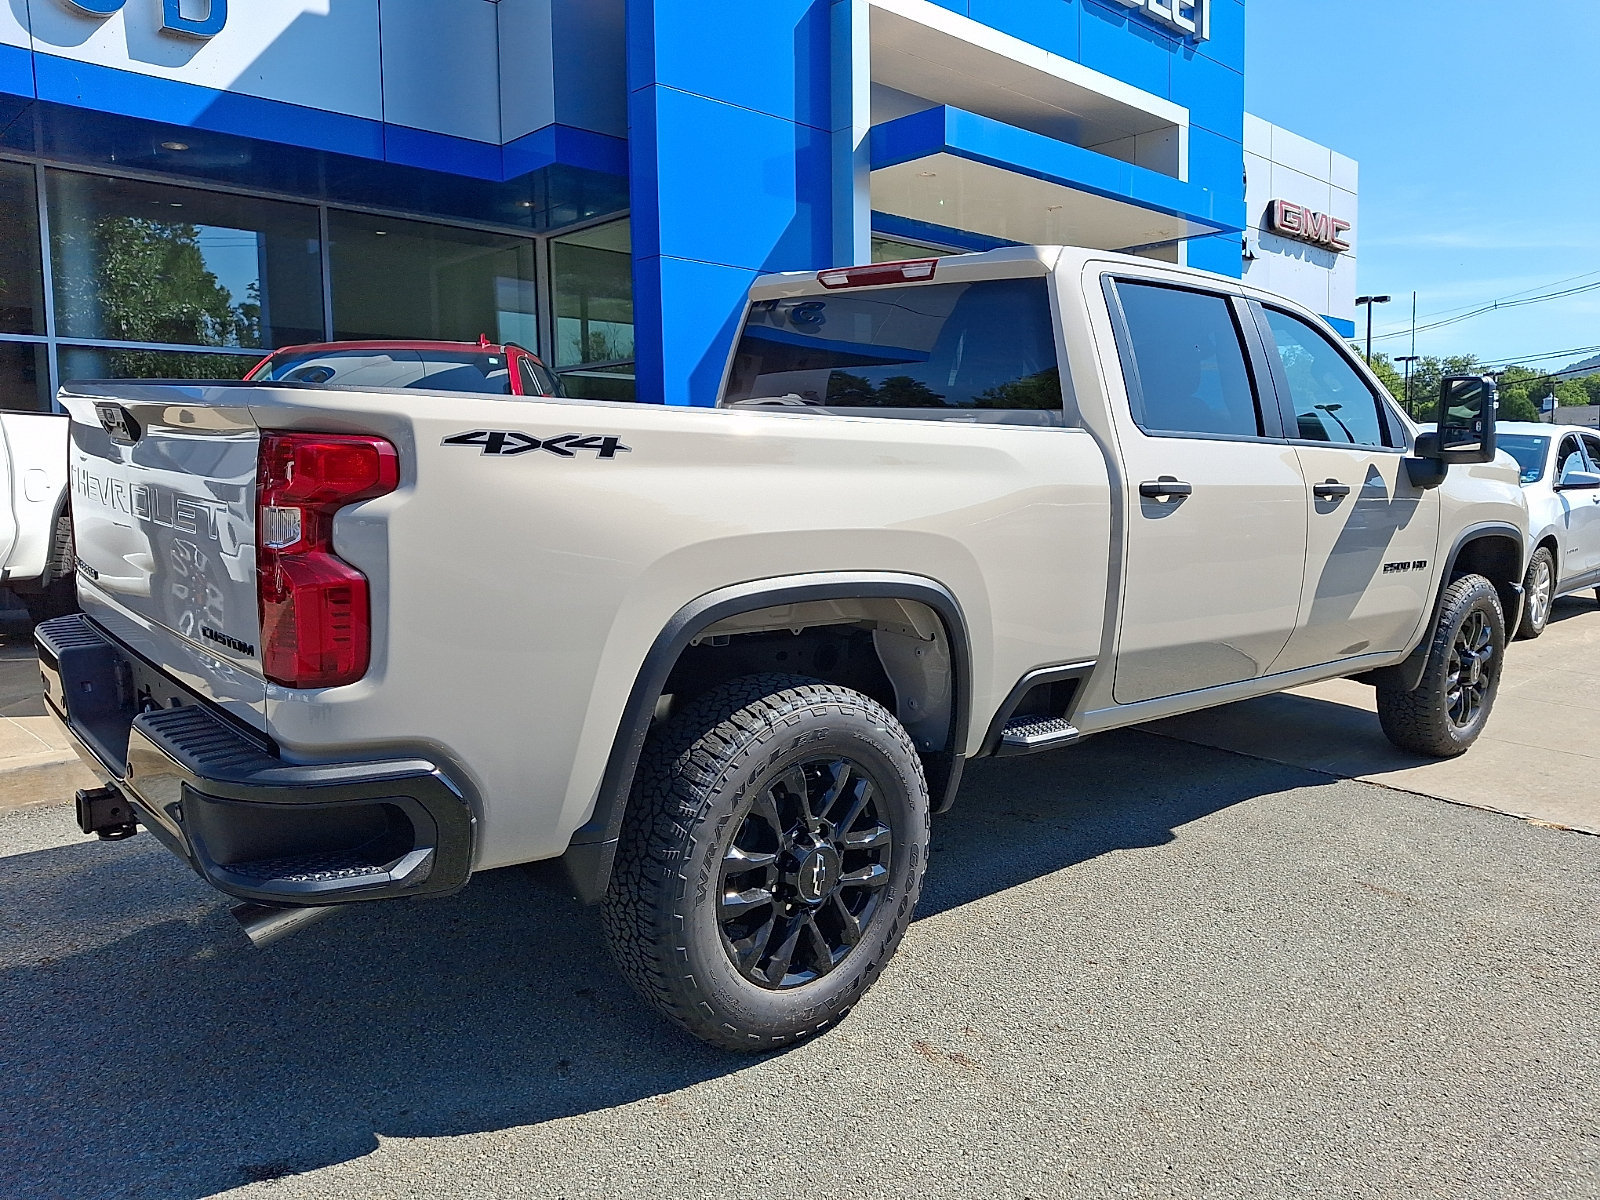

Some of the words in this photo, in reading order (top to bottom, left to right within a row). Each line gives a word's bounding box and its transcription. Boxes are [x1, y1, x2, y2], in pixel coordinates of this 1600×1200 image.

[1274, 199, 1351, 251] GMC
[1382, 561, 1411, 573] 2500
[1411, 560, 1428, 570] HD
[201, 625, 255, 657] CUSTOM
[696, 726, 830, 908] WRANGLER
[801, 842, 919, 1022] GOODYEAR
